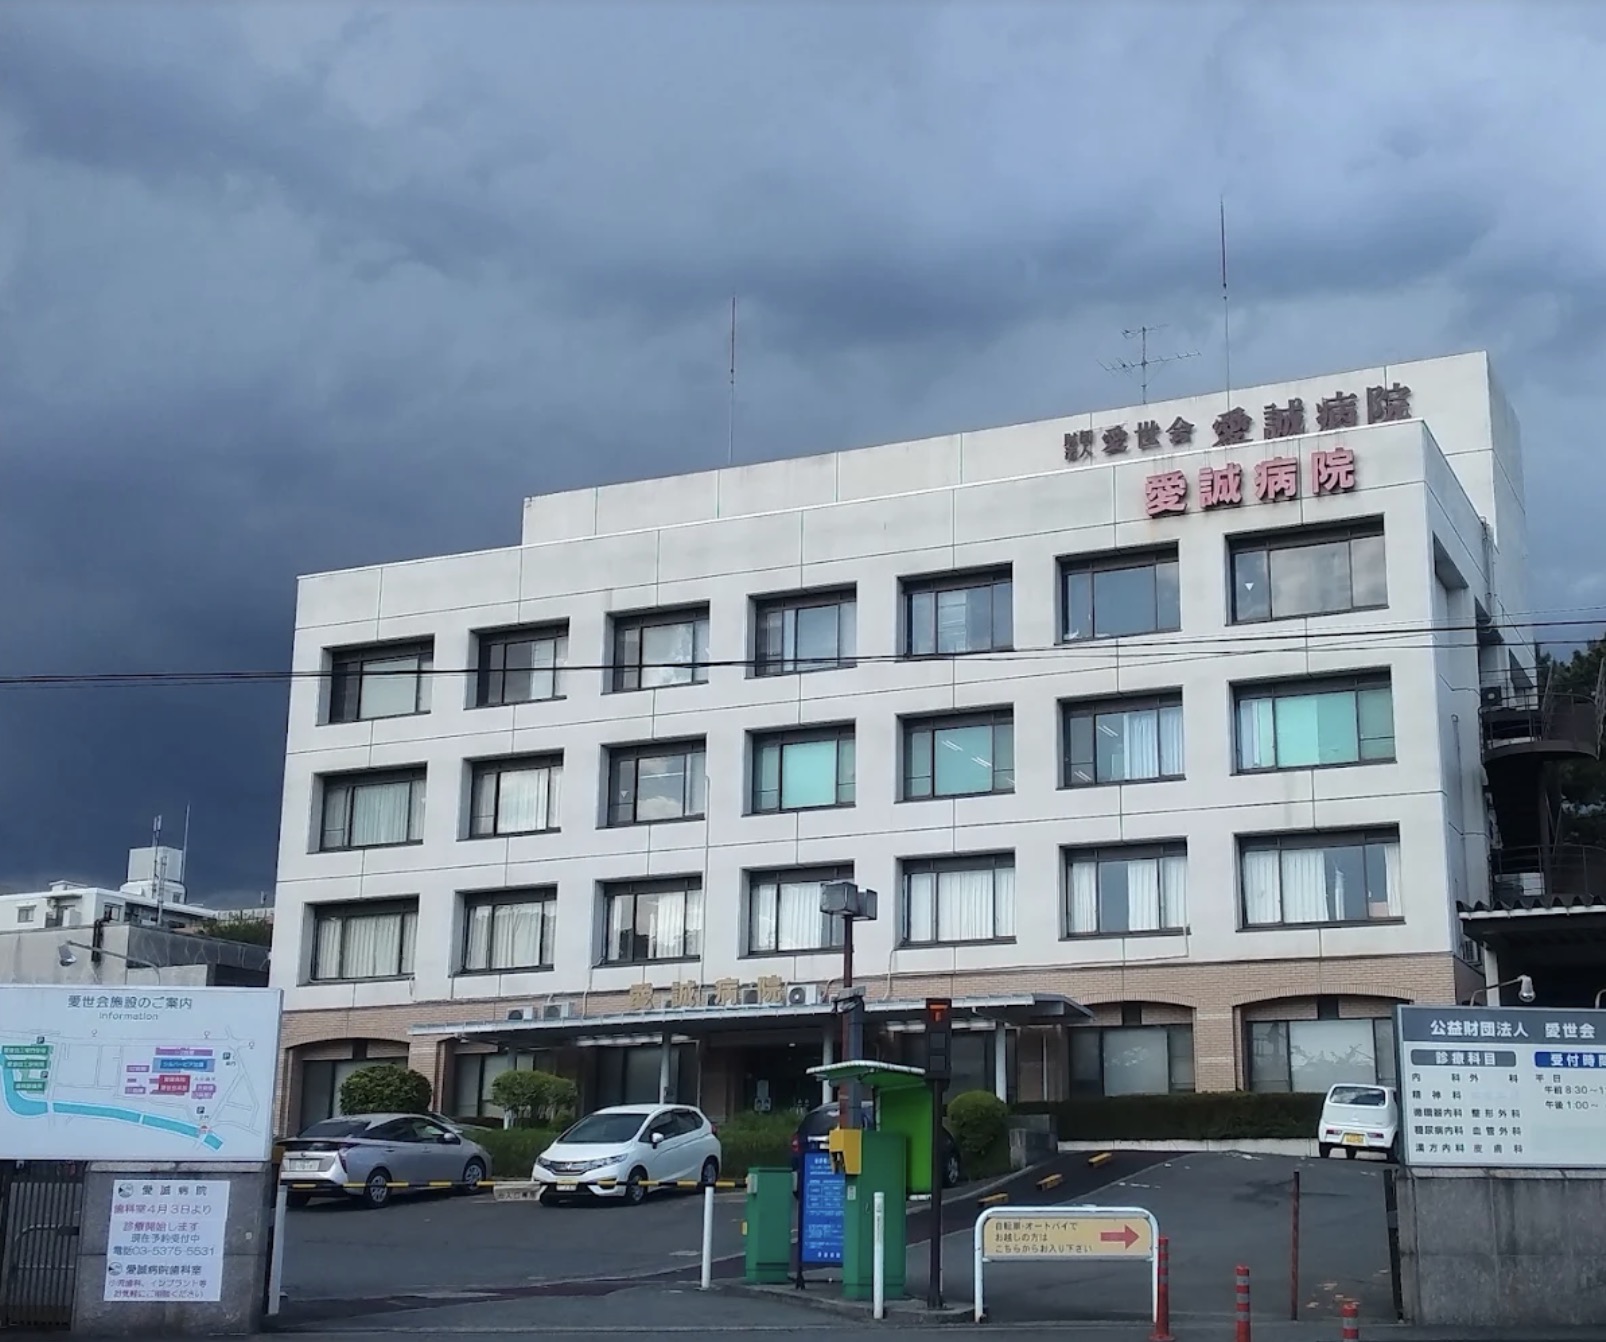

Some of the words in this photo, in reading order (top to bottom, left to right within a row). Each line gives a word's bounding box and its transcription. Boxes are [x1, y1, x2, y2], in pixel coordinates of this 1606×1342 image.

[1101, 416, 1195, 454] 愛世会
[1212, 383, 1412, 446] 愛誠病院
[1145, 447, 1355, 517] 愛誠病院
[630, 975, 783, 1009] 愛誠病院
[68, 995, 192, 1009] 愛世会施設のご案内
[1430, 1020, 1529, 1037] 公益財団法人
[1545, 1023, 1595, 1038] 愛世会
[1436, 1052, 1496, 1065] 診療科目
[1413, 1090, 1461, 1100] 精神科
[142, 1185, 207, 1196] 愛誠病院
[123, 1221, 199, 1232] 診療開始します
[995, 1233, 1048, 1242] お越しの方は
[995, 1244, 1093, 1253] こちらからお入り下さい
